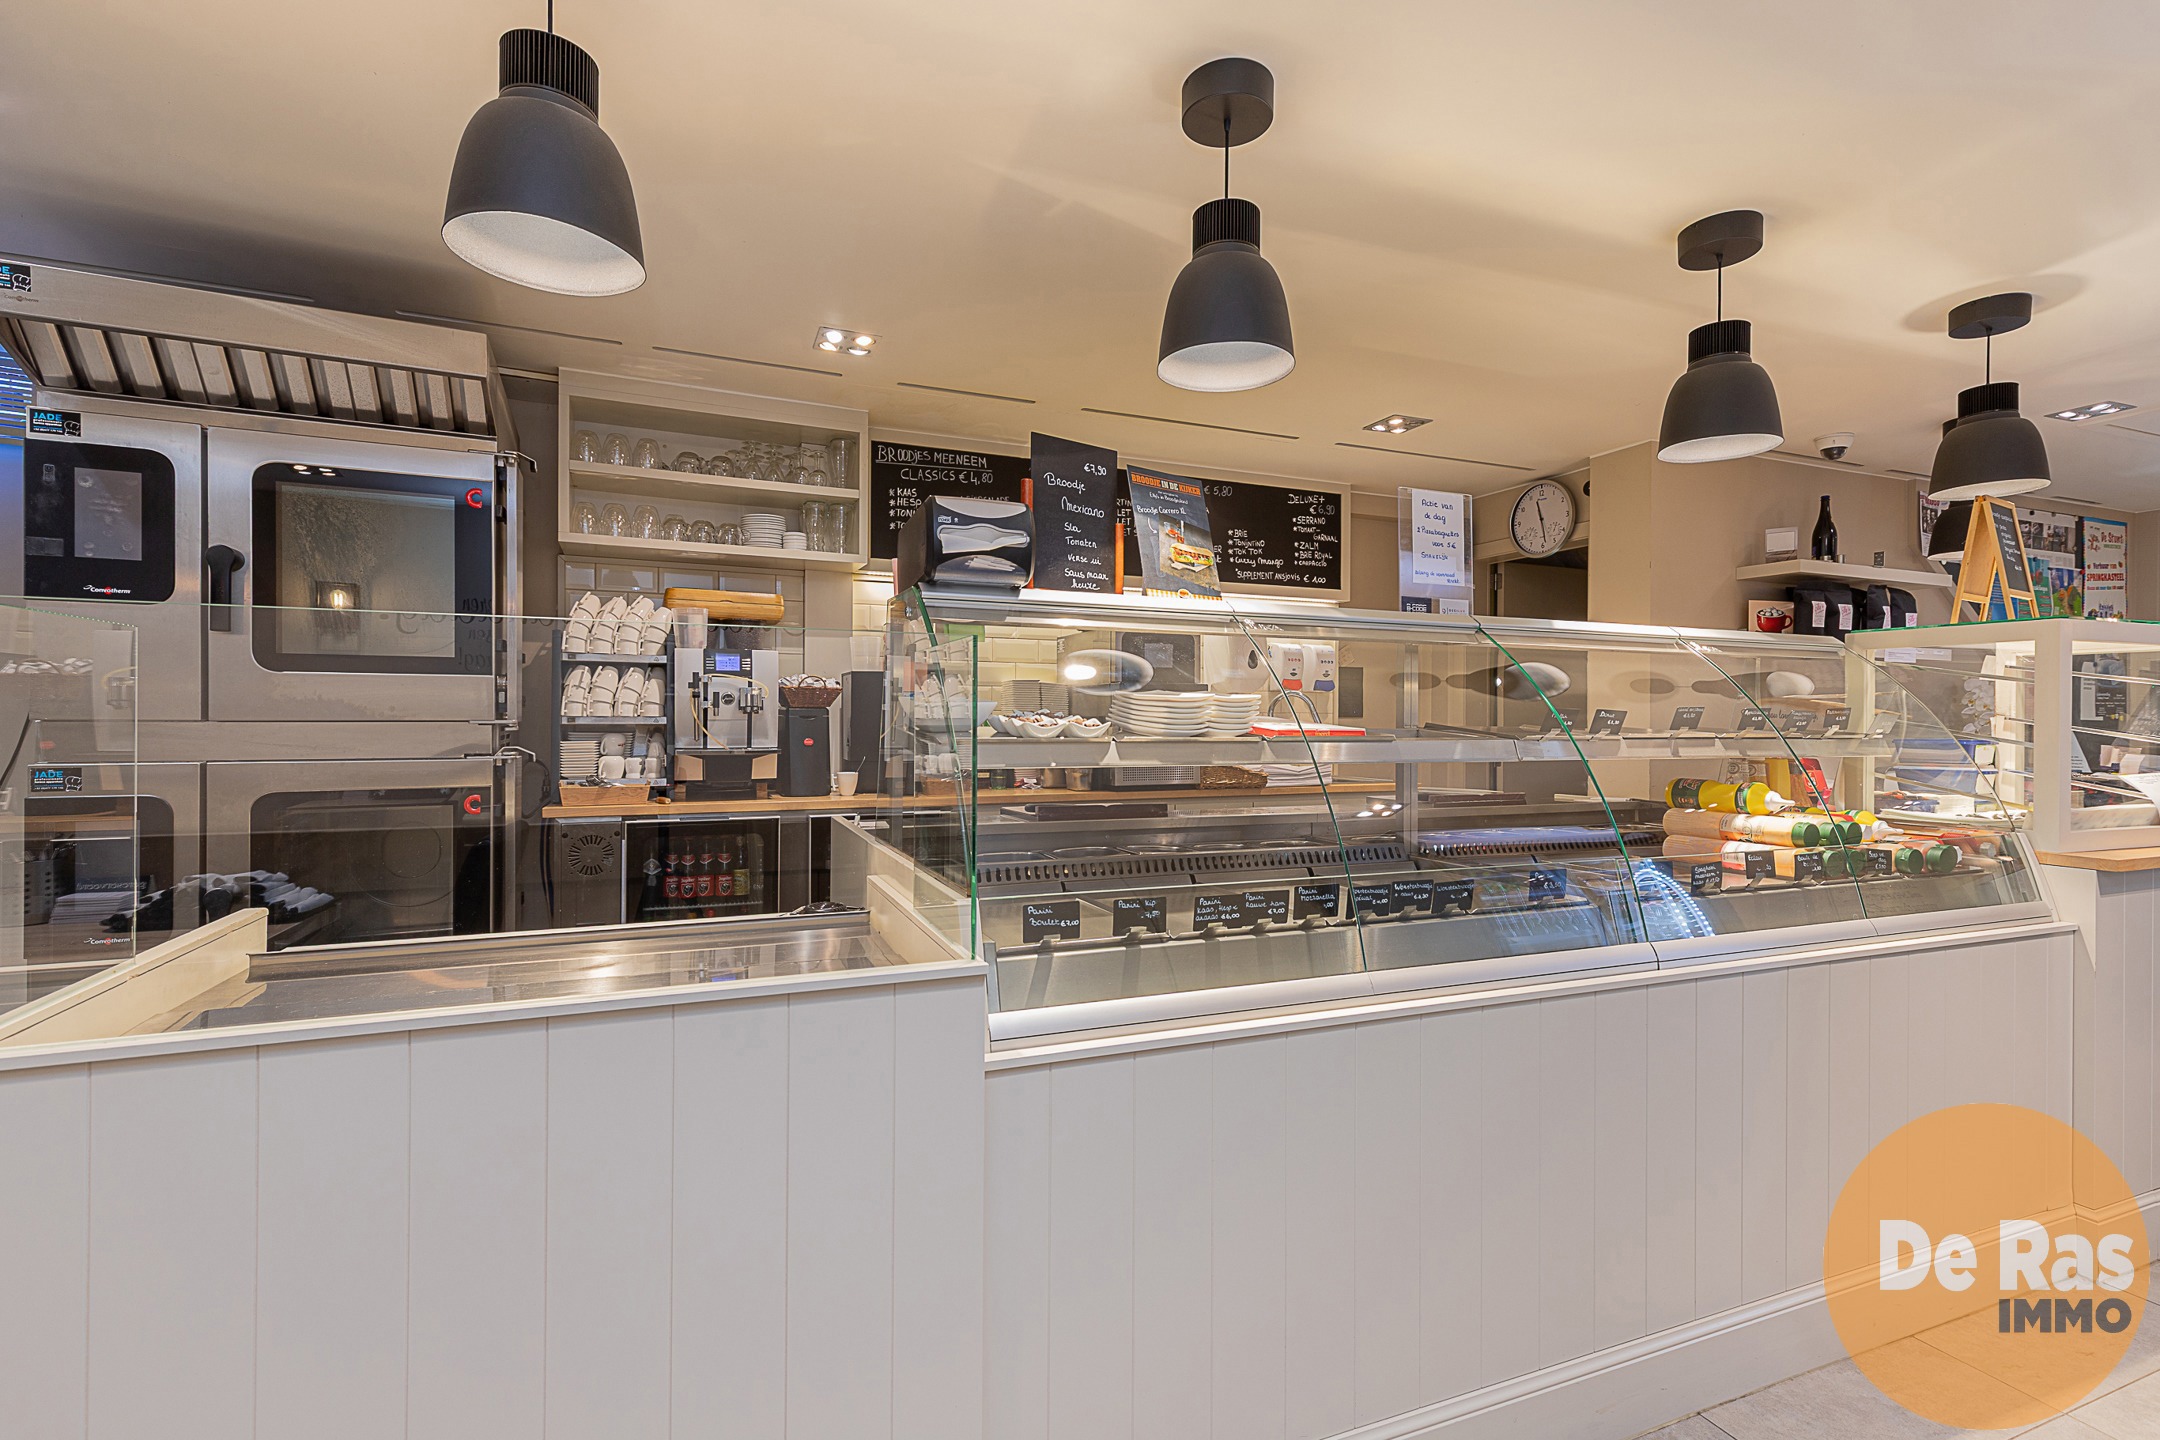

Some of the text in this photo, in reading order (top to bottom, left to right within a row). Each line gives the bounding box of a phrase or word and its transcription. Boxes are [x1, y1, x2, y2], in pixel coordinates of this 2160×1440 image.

[33, 411, 62, 421] JADE
[933, 452, 988, 469] MEENEEM
[1044, 472, 1085, 494] Broodje
[1131, 473, 1161, 487] BROODJE
[1161, 480, 1169, 489] IN
[1169, 482, 1178, 491] DE
[1179, 484, 1201, 495] KIJKER
[897, 487, 917, 498] KAAS
[1061, 496, 1104, 518] Mexicano
[1137, 504, 1158, 515] Broodje
[1421, 499, 1454, 511] Actie van
[1297, 516, 1326, 525] SERRANO
[1433, 512, 1446, 524] dag
[1064, 521, 1081, 533] Sla
[1065, 536, 1097, 549] Tomaten
[1299, 541, 1319, 550] ZALM
[1064, 568, 1085, 579] Saus
[1237, 570, 1273, 581] SUPPLEMENT
[2087, 573, 2124, 582] SPRINGKASTEEL
[34, 770, 63, 778] JADE
